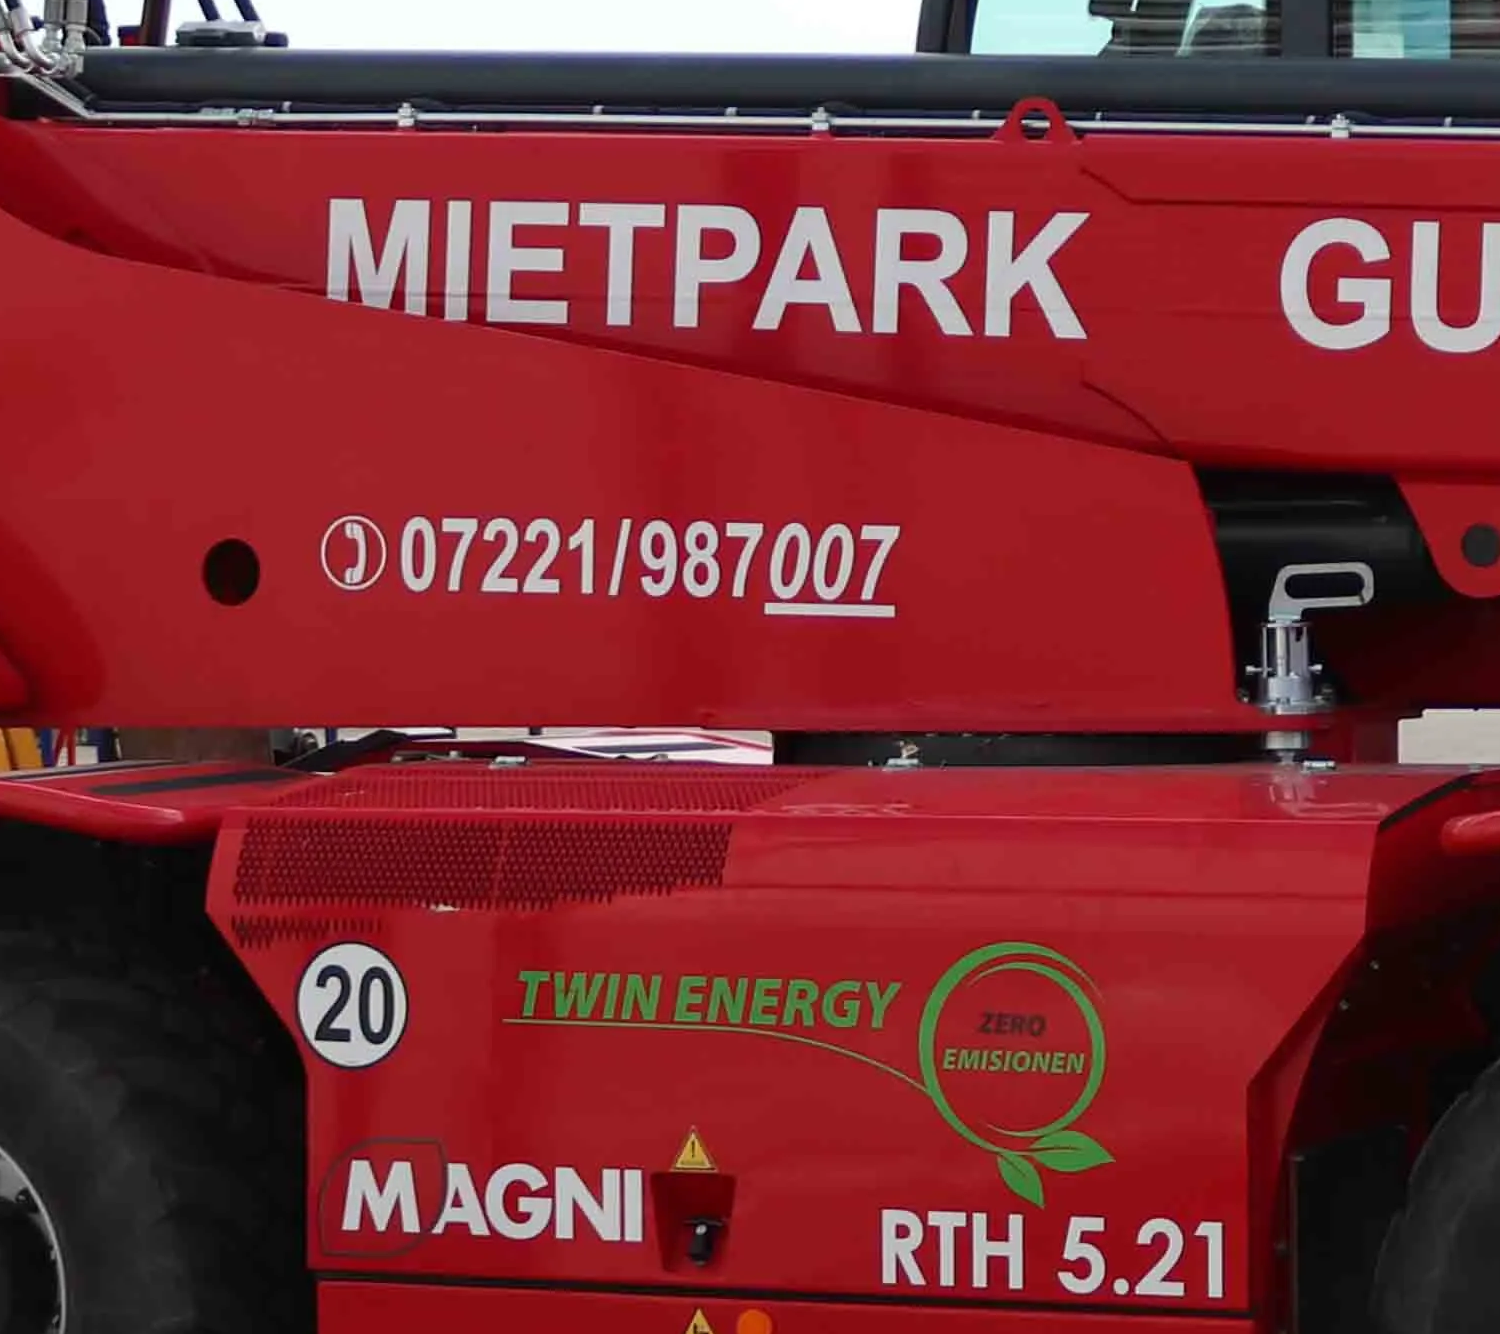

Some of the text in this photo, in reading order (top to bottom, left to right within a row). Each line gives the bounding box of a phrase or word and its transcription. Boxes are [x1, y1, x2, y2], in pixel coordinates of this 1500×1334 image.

[326, 198, 1091, 340] MIETPARK
[400, 516, 901, 603] 07221/987007
[313, 965, 394, 1044] 20
[518, 970, 902, 1028] TWIN ENERGY
[977, 1012, 1047, 1038] ZERO
[942, 1049, 1085, 1075] EMISIONEN
[341, 1159, 643, 1243] MAGNI
[881, 1209, 1224, 1299] RTH 5.21
